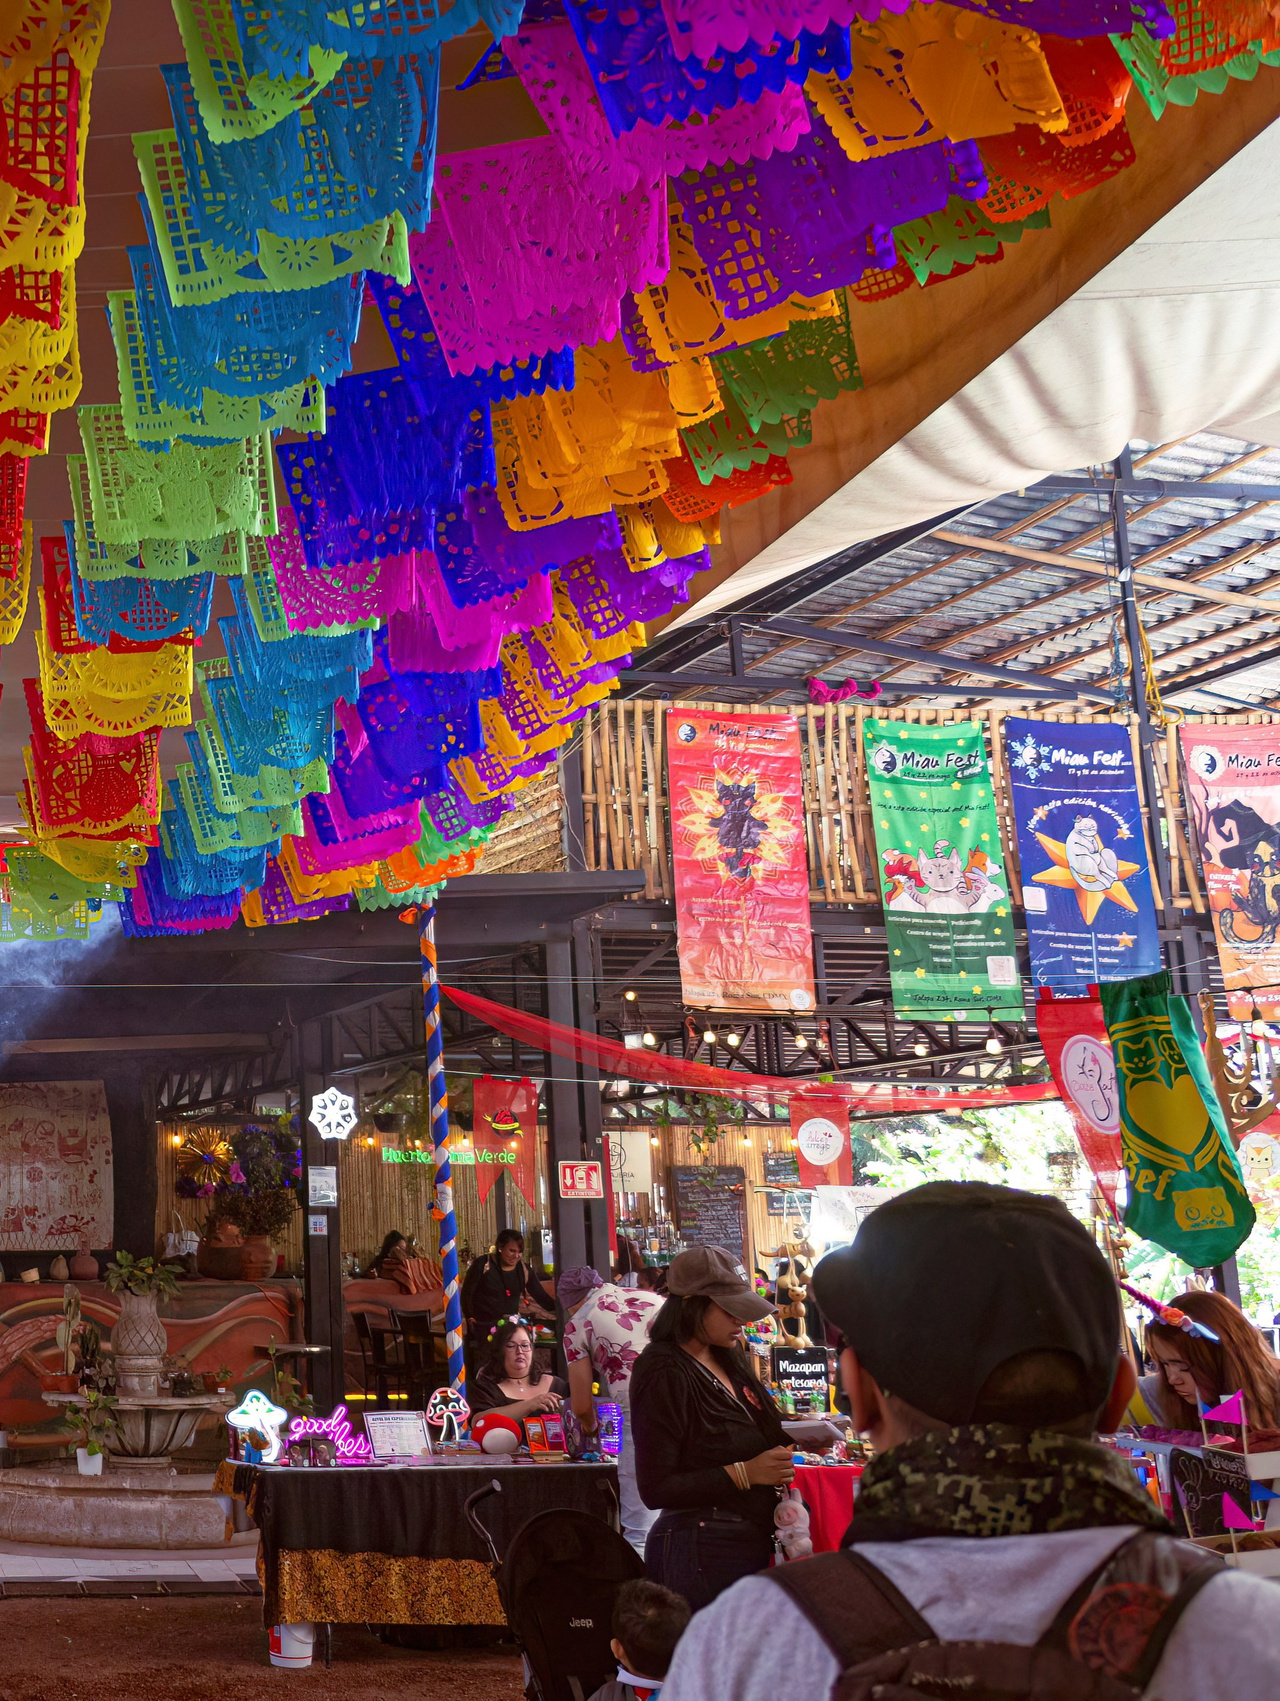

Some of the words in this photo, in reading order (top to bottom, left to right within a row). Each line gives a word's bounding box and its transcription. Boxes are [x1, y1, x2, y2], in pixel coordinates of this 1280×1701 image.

[709, 723, 740, 737] Miau
[901, 751, 940, 769] Miau
[945, 750, 979, 768] Fest
[1051, 748, 1089, 766] Miau
[1093, 750, 1125, 766] Fest
[1228, 754, 1262, 769] Miau
[1063, 797, 1097, 808] edición
[382, 1147, 431, 1163] Huerto
[475, 1148, 516, 1164] Verde
[779, 1360, 825, 1375] Mazapan
[289, 1405, 347, 1441] good
[570, 1617, 593, 1628] Jeep
